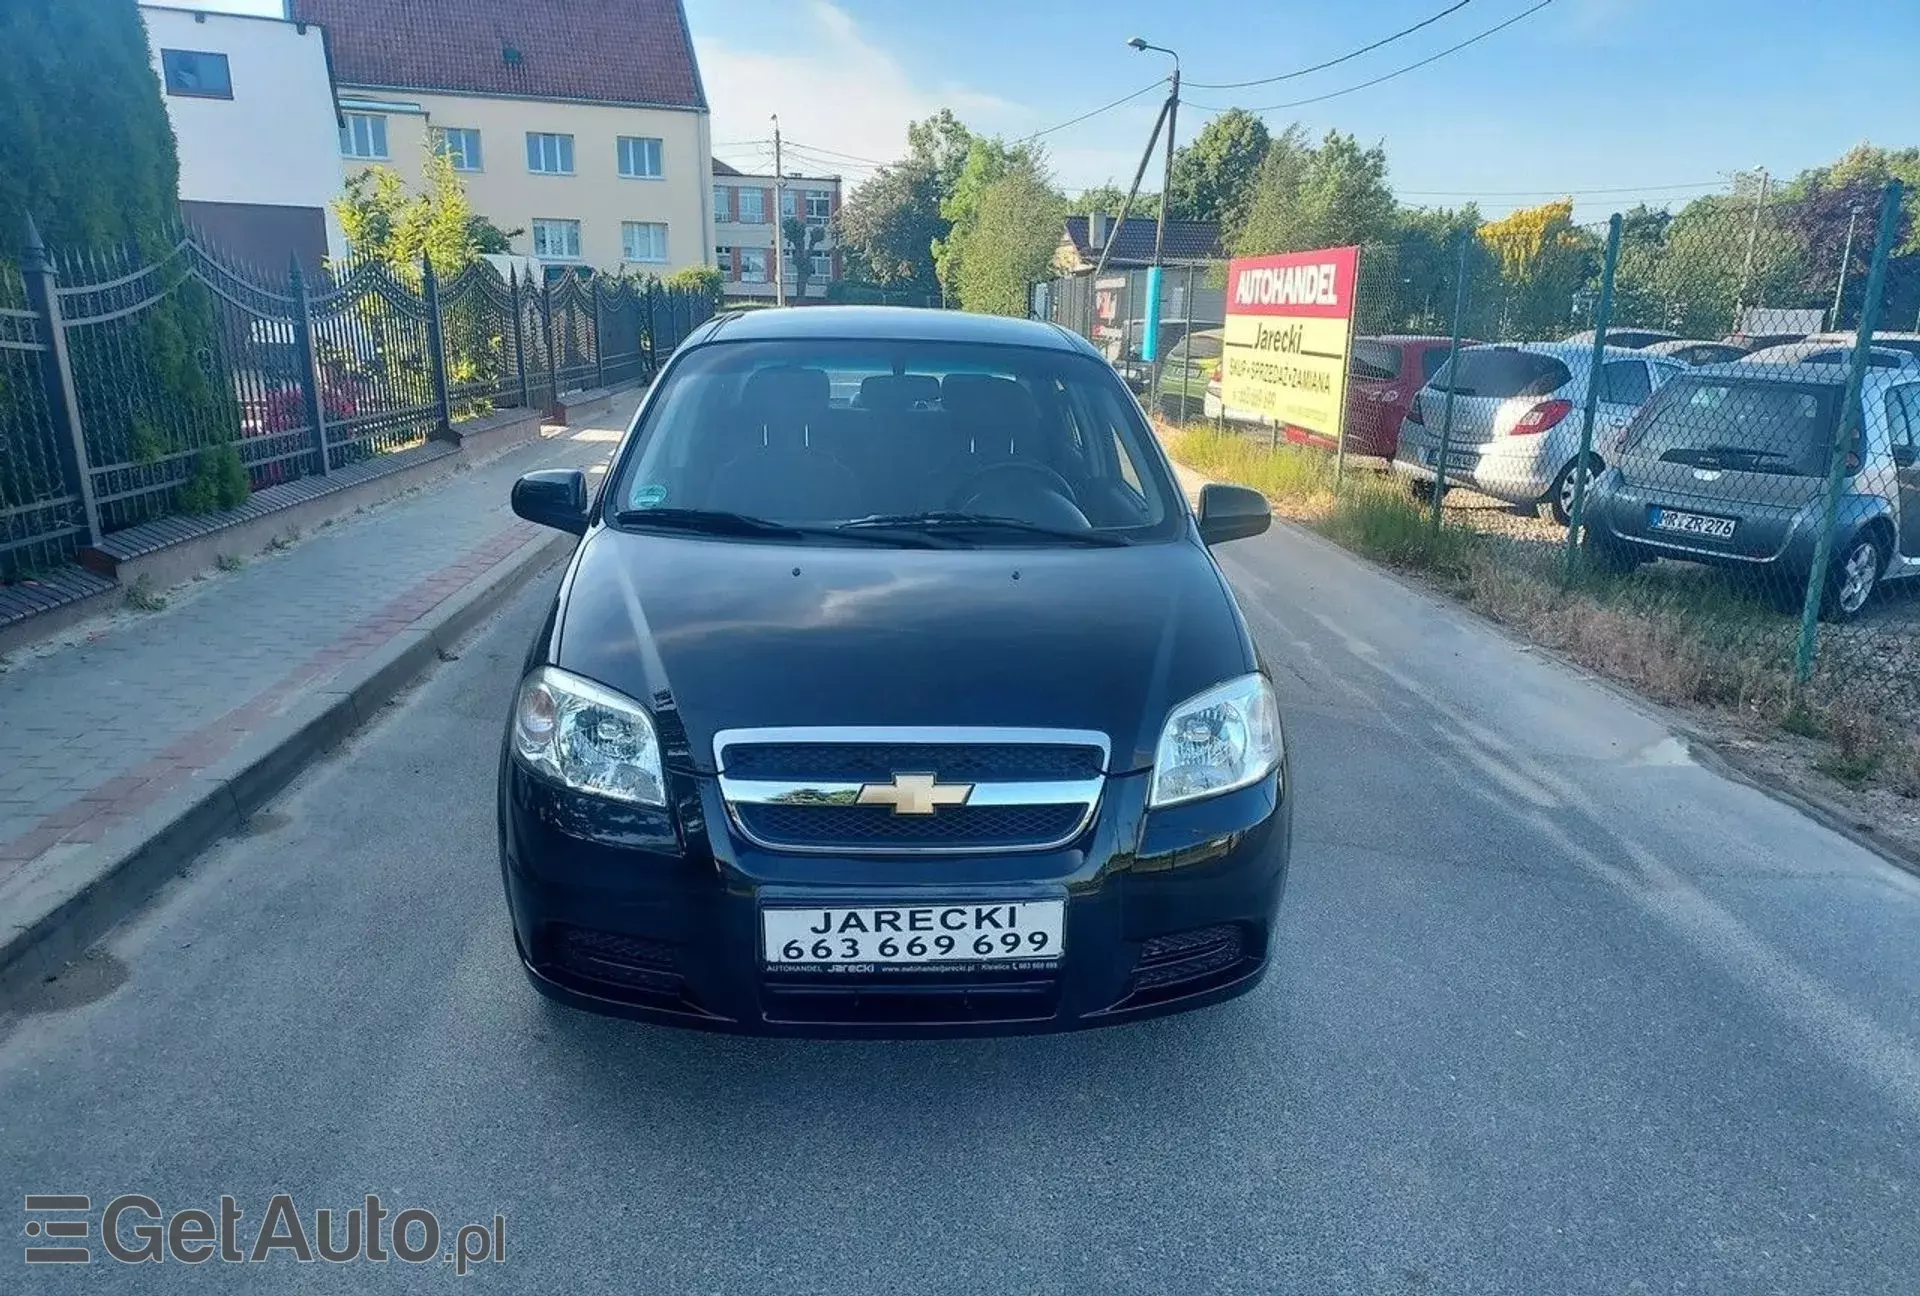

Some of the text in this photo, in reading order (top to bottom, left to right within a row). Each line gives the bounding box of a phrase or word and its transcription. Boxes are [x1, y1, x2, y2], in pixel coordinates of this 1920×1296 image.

[1235, 264, 1338, 306] AUTOHANDEL
[1255, 322, 1303, 354] Jarecki
[1684, 516, 1704, 531] ZR
[1705, 519, 1732, 536] 276
[810, 906, 1017, 934] JARECKI
[782, 931, 1049, 960] 663 669 699
[766, 964, 823, 973] AUTOHANDEL
[827, 963, 875, 973] Jarecki
